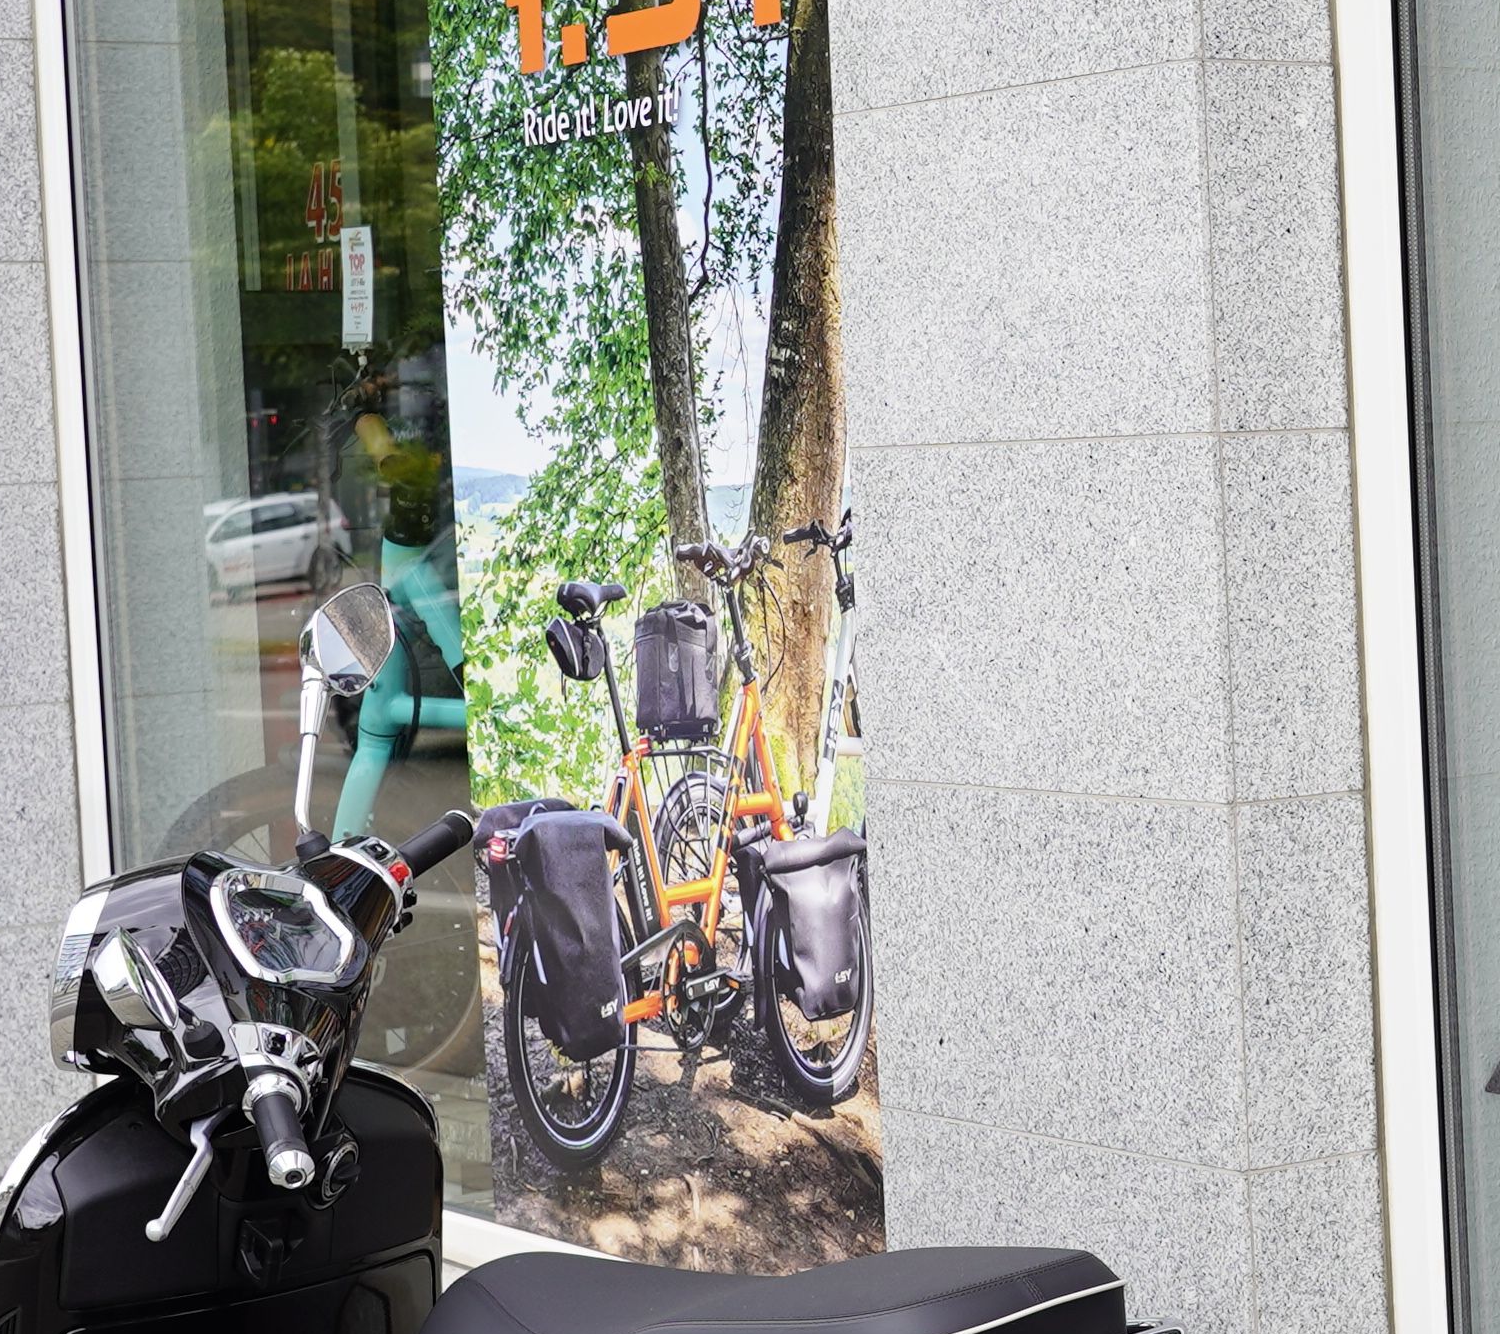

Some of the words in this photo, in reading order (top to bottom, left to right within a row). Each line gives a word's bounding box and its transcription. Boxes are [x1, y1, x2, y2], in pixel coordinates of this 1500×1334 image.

[524, 102, 572, 147] Ride
[574, 98, 597, 137] it!
[602, 93, 653, 134] Love
[657, 82, 680, 122] it!
